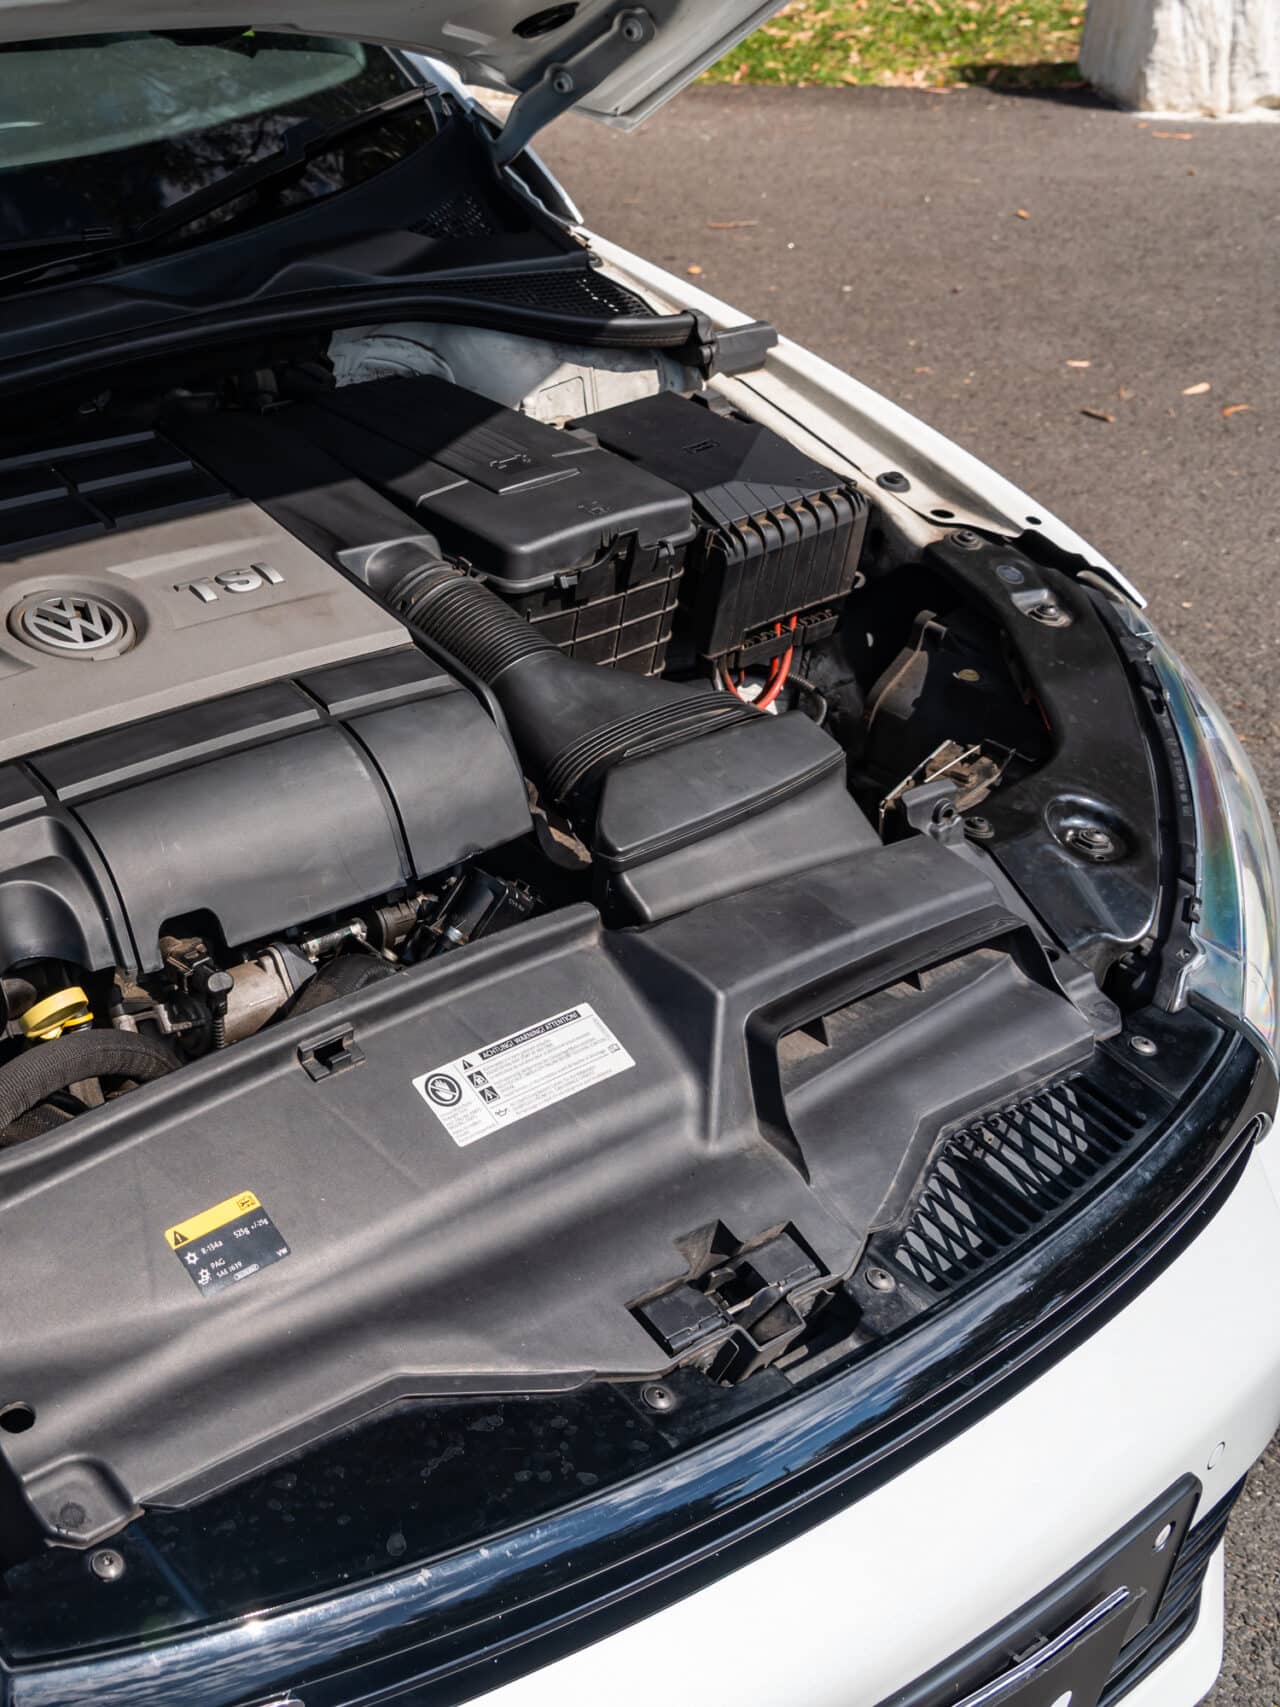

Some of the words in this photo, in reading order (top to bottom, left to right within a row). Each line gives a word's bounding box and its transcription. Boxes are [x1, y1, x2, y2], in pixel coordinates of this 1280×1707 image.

[173, 562, 286, 604] TSI
[24, 596, 120, 650] VW
[482, 1041, 515, 1058] ACHTUNG!
[513, 1026, 546, 1044] WARNING!
[545, 1012, 578, 1030] ATTENTION!
